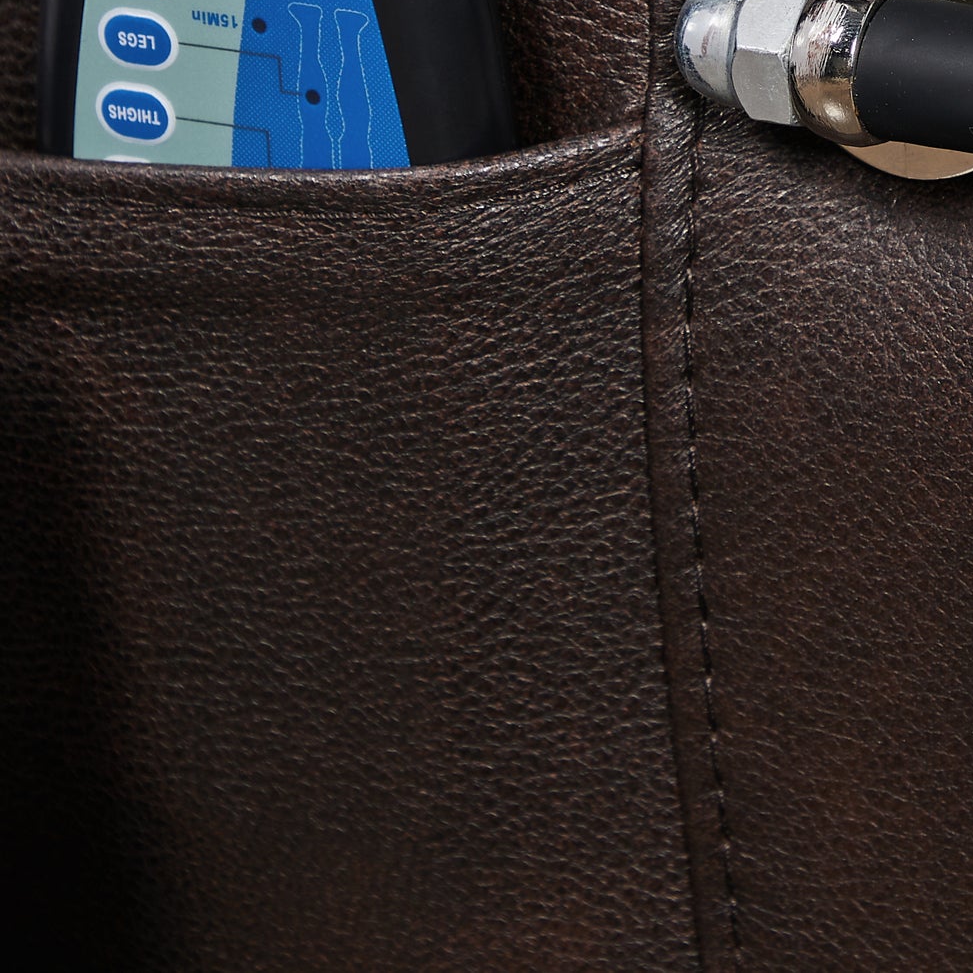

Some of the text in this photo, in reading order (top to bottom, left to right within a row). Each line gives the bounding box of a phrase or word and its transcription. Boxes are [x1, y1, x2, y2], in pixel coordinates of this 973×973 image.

[191, 9, 238, 29] 15Min
[117, 30, 156, 51] LEGS
[108, 103, 161, 126] THIGHS
